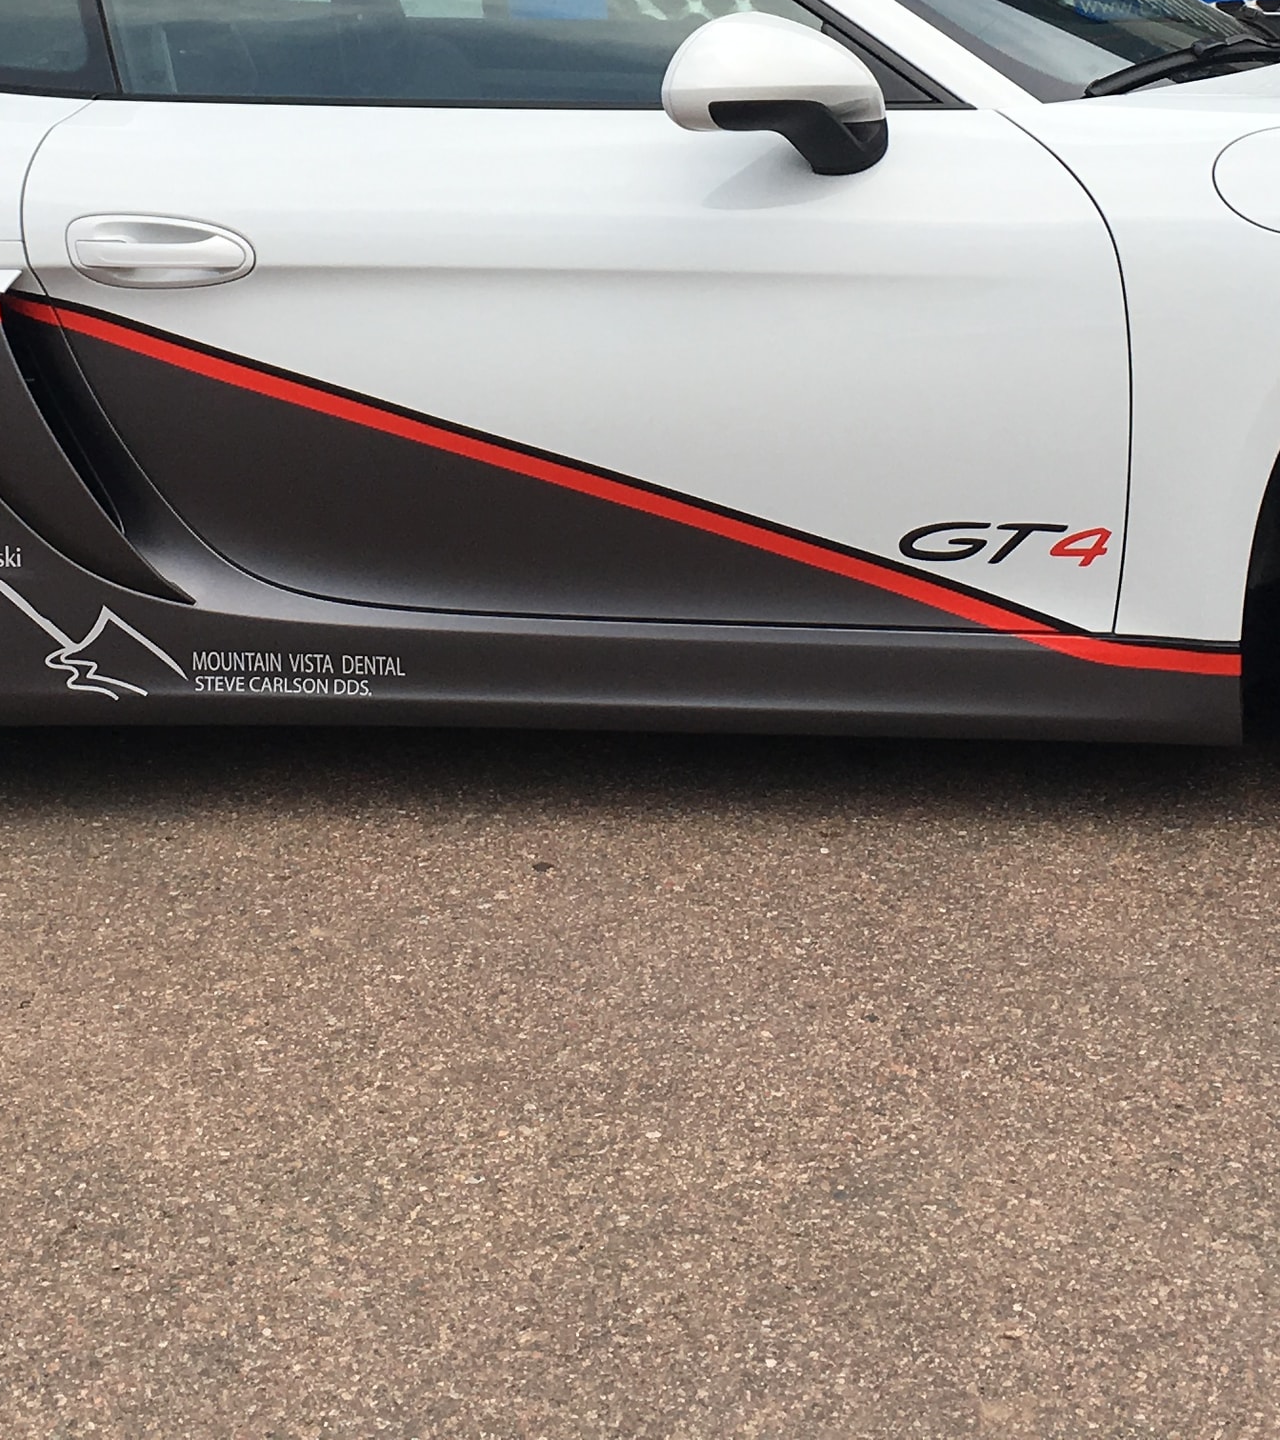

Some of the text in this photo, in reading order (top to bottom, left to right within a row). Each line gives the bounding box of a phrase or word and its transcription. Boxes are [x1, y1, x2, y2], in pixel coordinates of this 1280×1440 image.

[899, 521, 1112, 567] GT4
[192, 651, 406, 676] MOUNTAIN VISTA DENTAL
[195, 676, 372, 696] STEVE CARLSON DDS.
